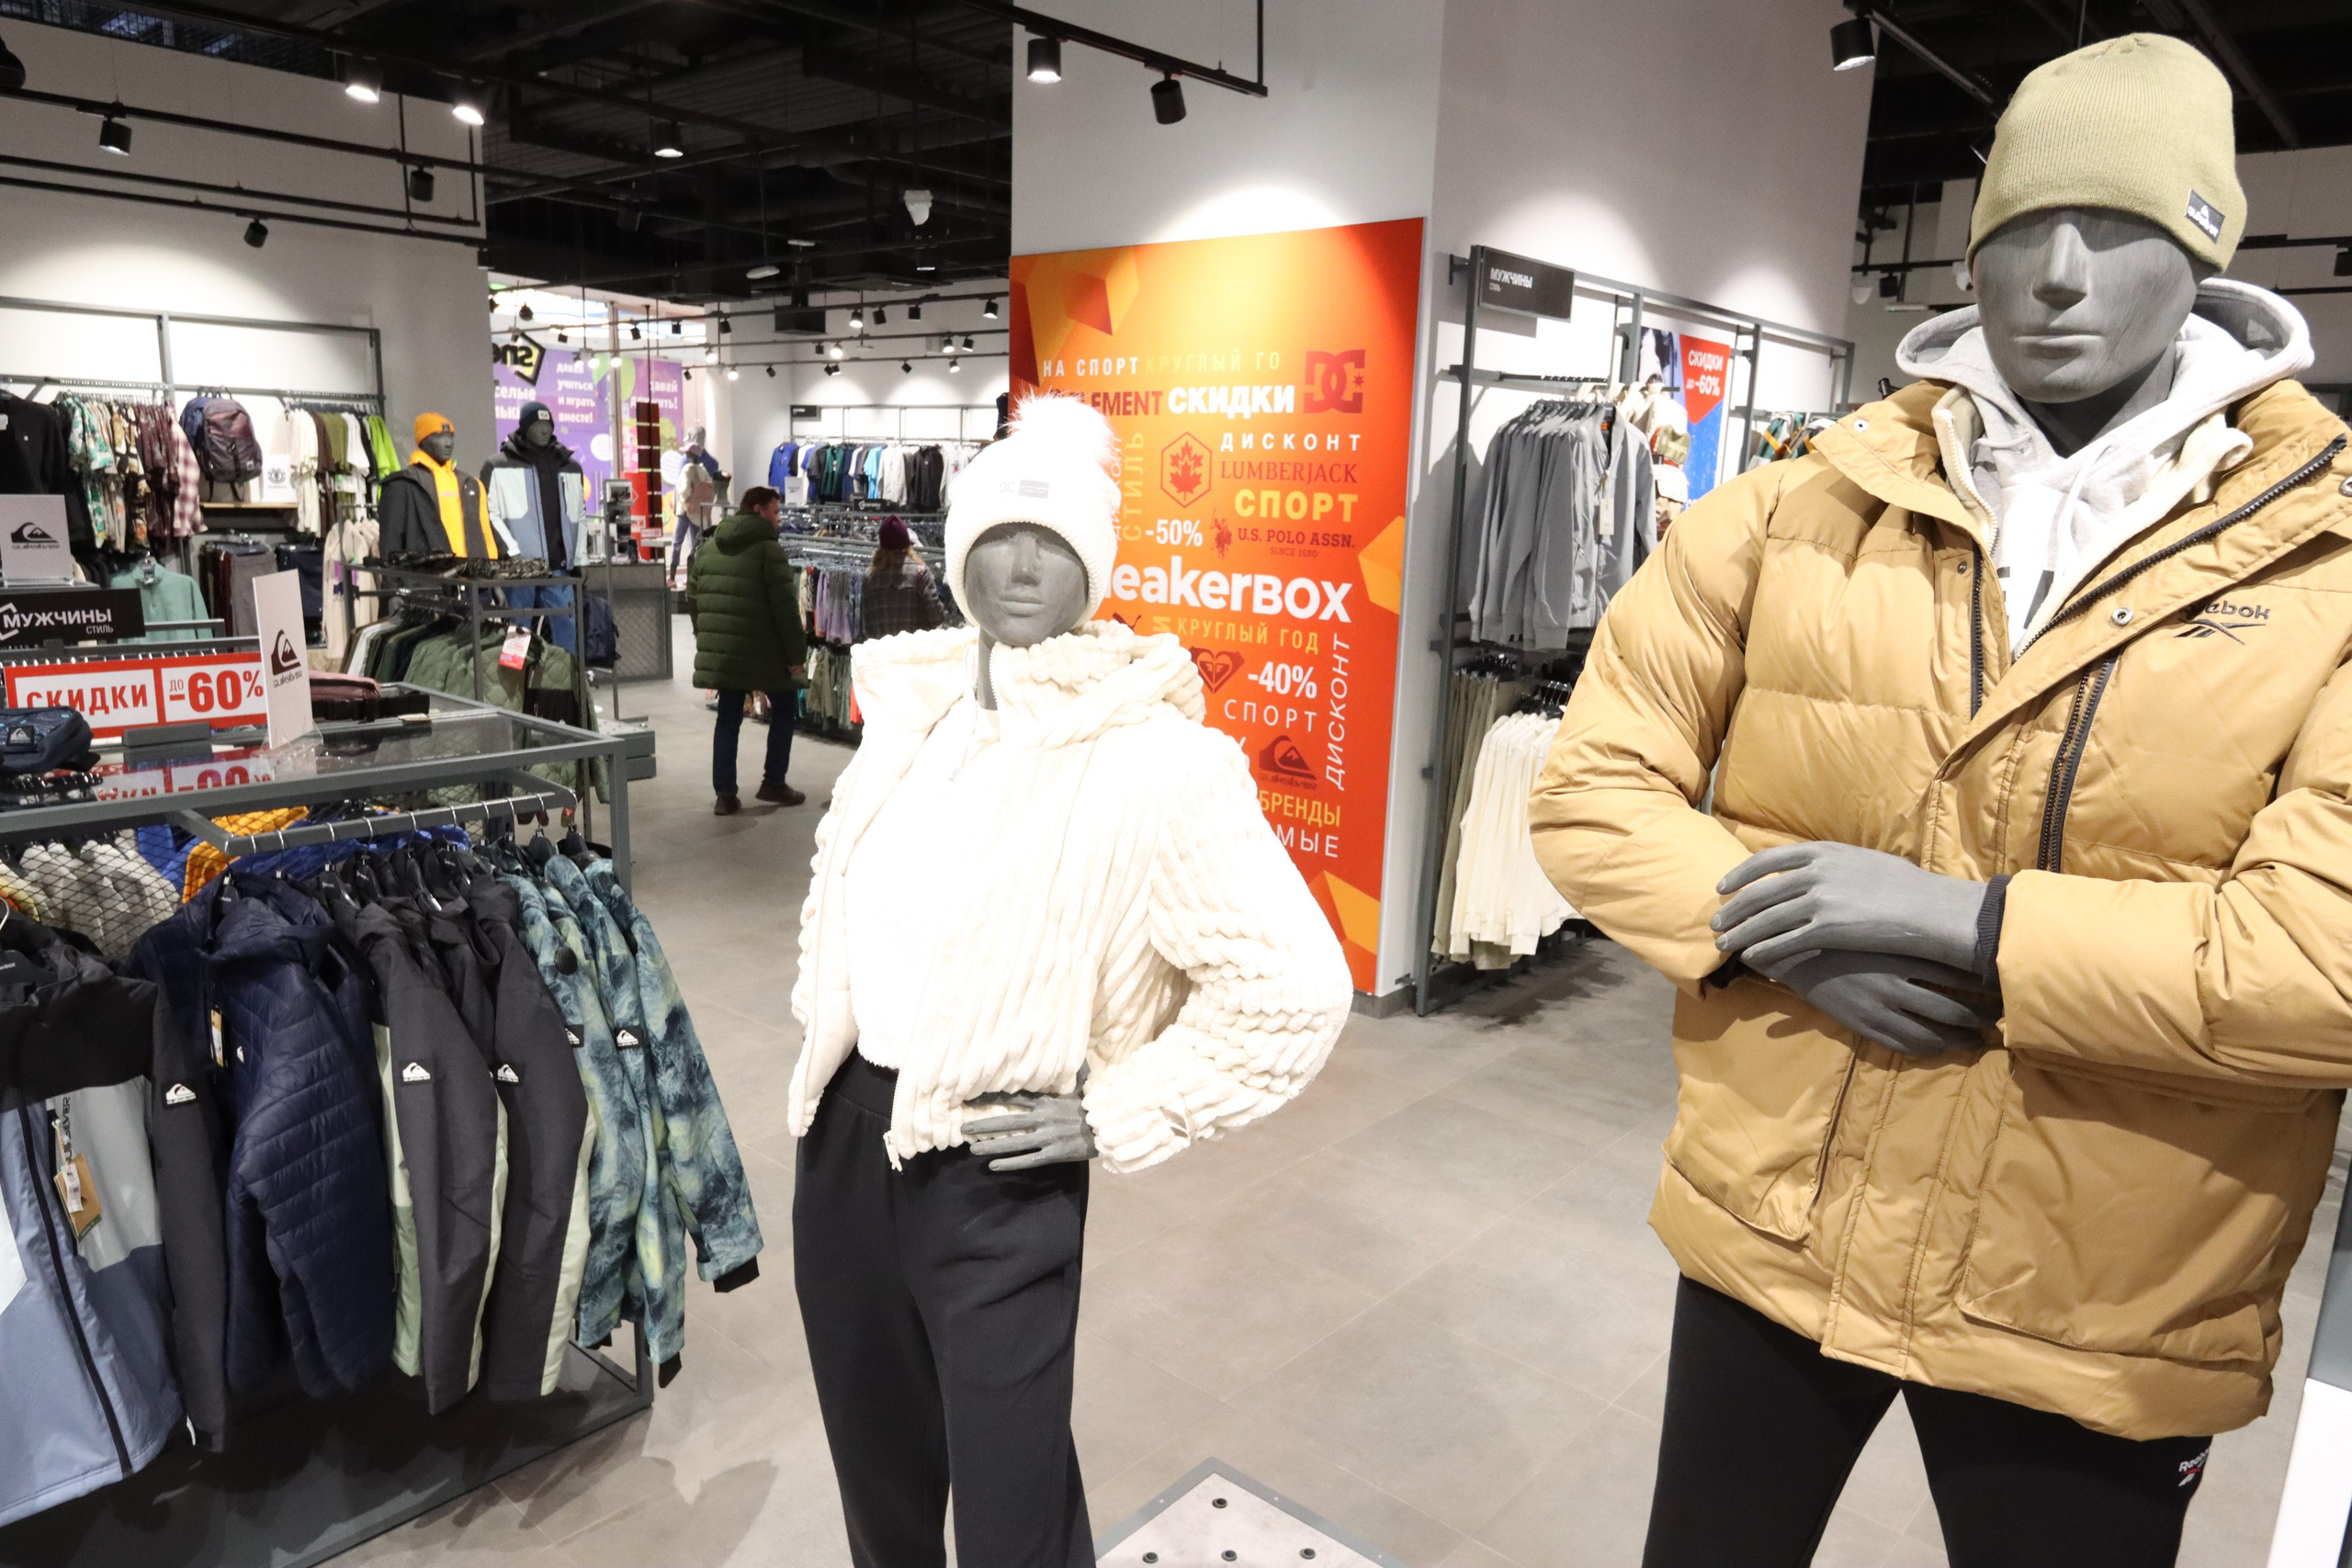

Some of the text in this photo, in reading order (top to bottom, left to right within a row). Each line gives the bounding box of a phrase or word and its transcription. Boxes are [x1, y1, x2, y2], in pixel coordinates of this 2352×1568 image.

[1490, 267, 1533, 289] МУЖЧИНЫ
[1043, 356, 1139, 378] НА СПОРТ
[1145, 348, 1281, 374] КРУГЛЫЙ ГО
[1689, 349, 1724, 372] СКИДКИ
[1695, 374, 1721, 397] -60%
[1168, 385, 1295, 420] СКИДКИ
[1220, 433, 1362, 453] ДИСКОНТ
[1123, 433, 1145, 542] СТИЛЬ
[1220, 460, 1359, 485] LUMBERJACK
[1235, 489, 1359, 523] СПОРТ
[1145, 518, 1204, 547] -50%
[1237, 527, 1356, 548] U.S. POLO ASSN.
[3, 608, 112, 629] МУЖЧИНЫ
[1177, 616, 1269, 646] КРУГЛЫЙ
[1280, 628, 1319, 655] ГОД
[169, 669, 265, 714] -60%
[1248, 660, 1318, 699] -40%
[26, 683, 148, 716] СКИДКИ
[1325, 632, 1351, 792] ДИСКОНТ
[1224, 699, 1317, 732] СПОРТ
[1259, 790, 1341, 828] БРЕНДЫ
